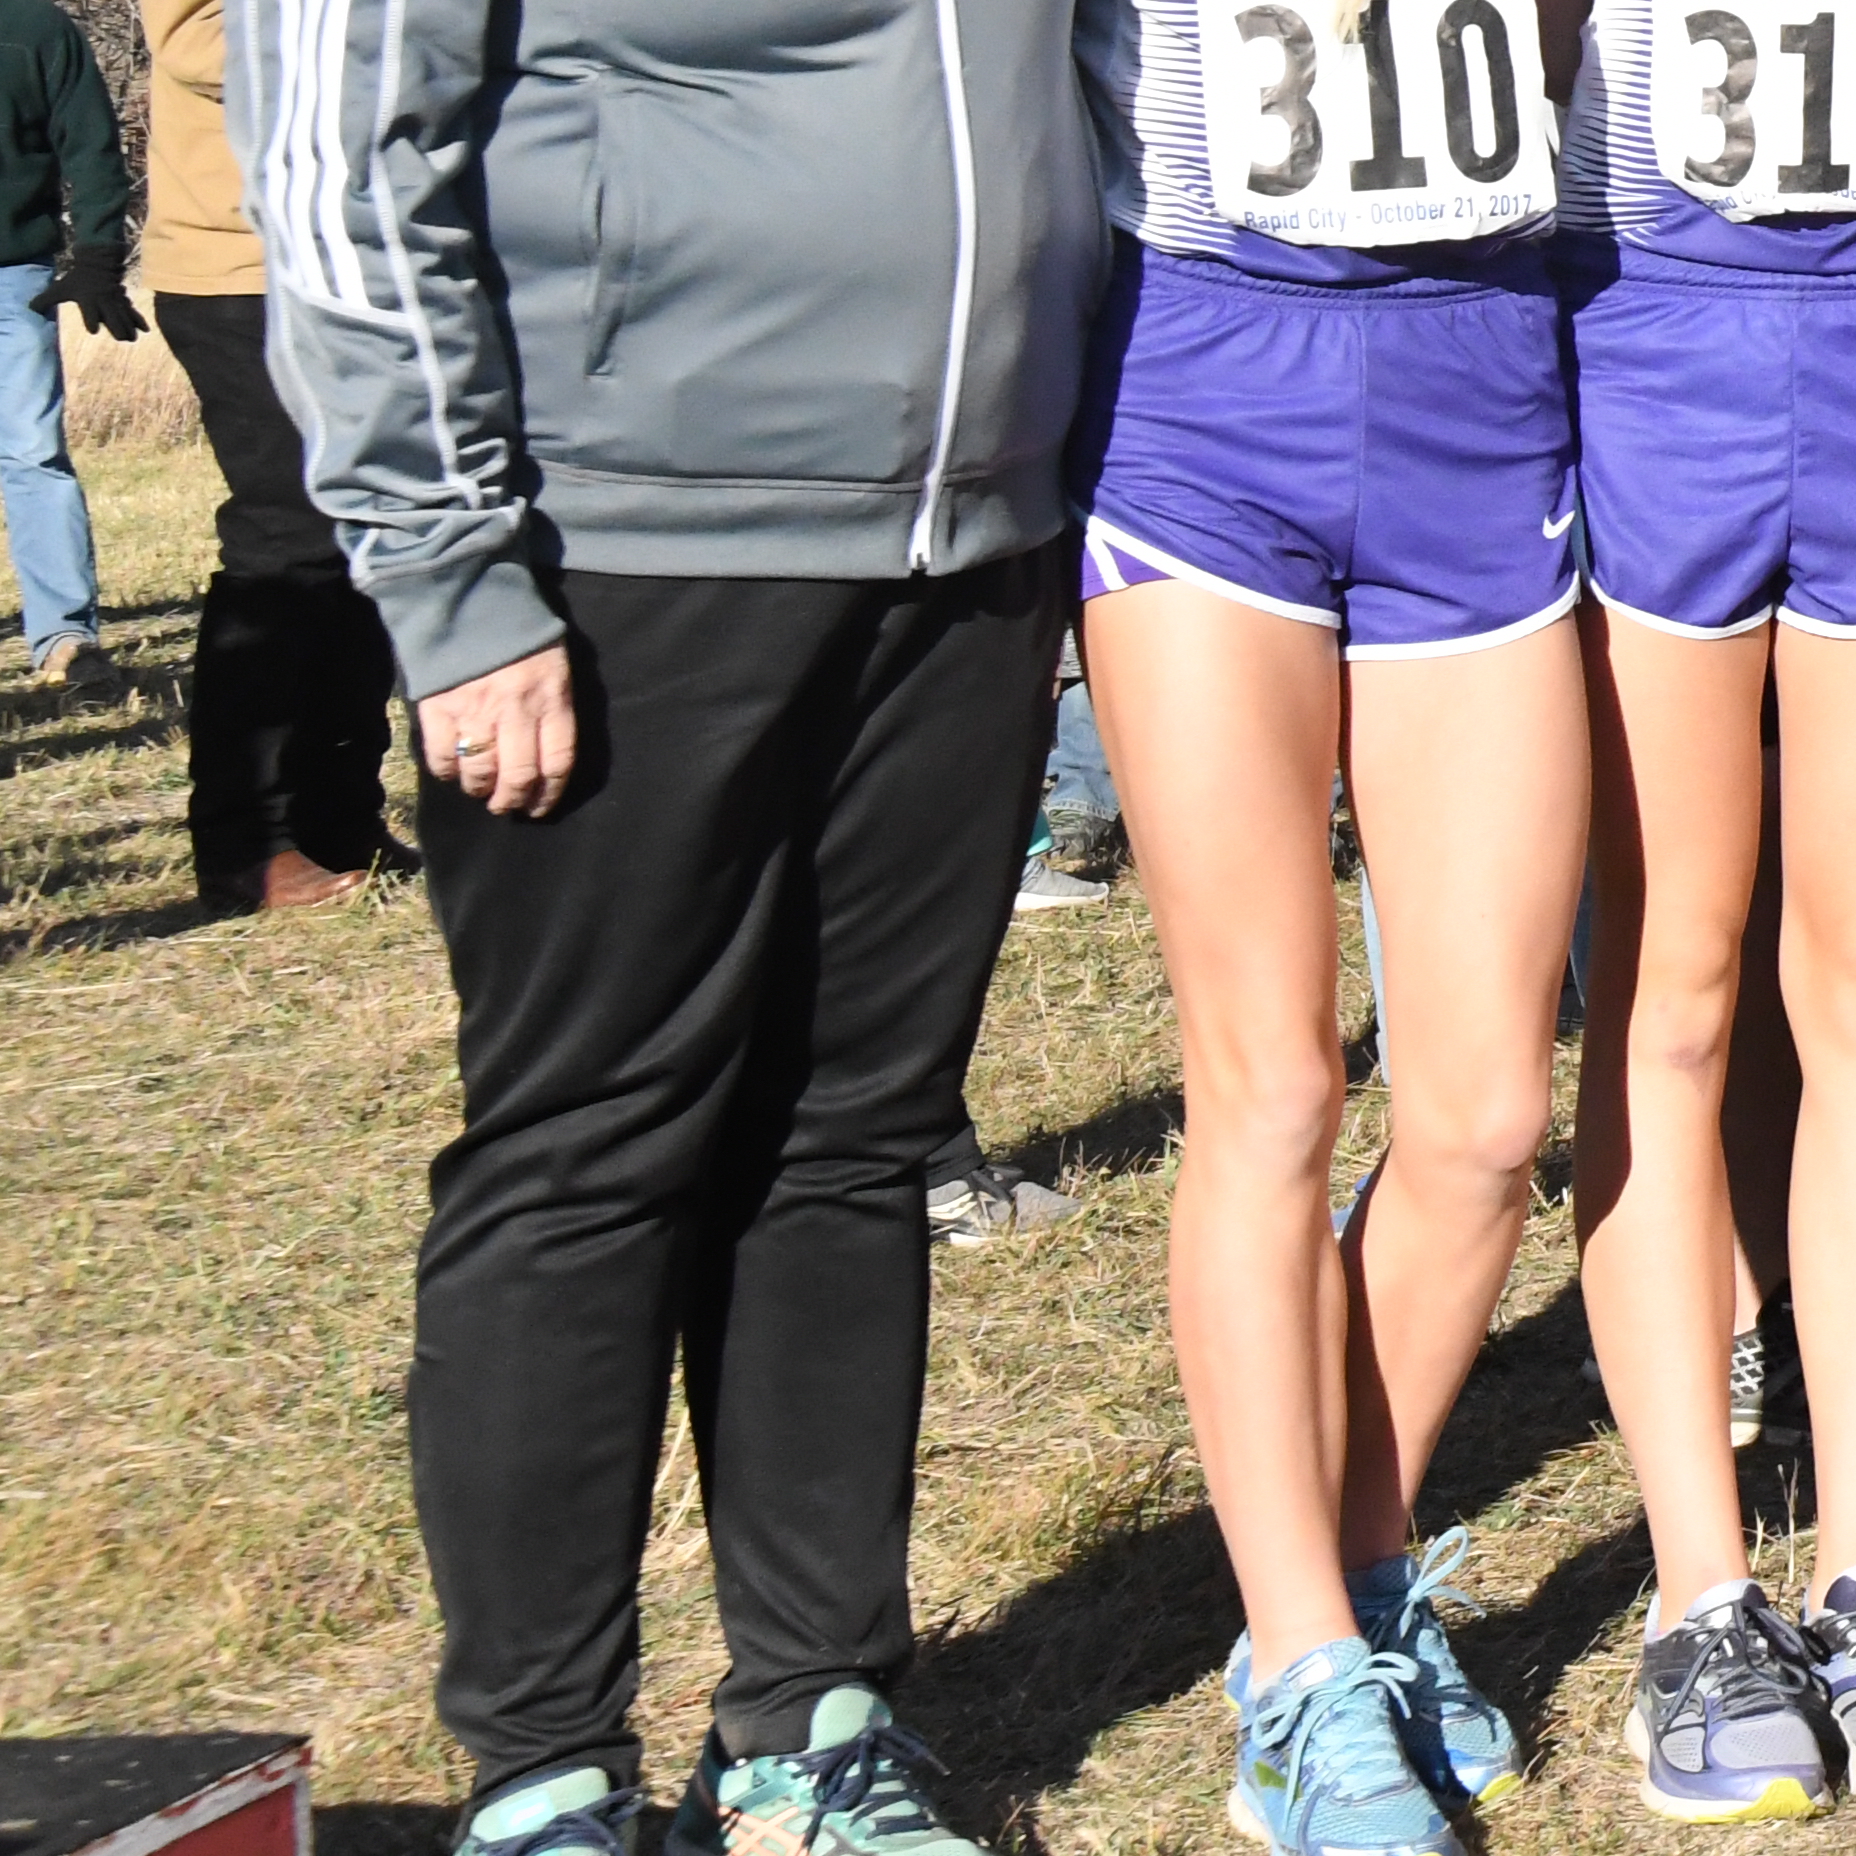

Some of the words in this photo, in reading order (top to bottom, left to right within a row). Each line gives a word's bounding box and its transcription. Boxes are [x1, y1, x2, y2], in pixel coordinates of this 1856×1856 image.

[1244, 209, 1300, 232] Rapid
[1308, 207, 1347, 232] City
[1371, 198, 1446, 224] October
[1488, 193, 1533, 218] 2017
